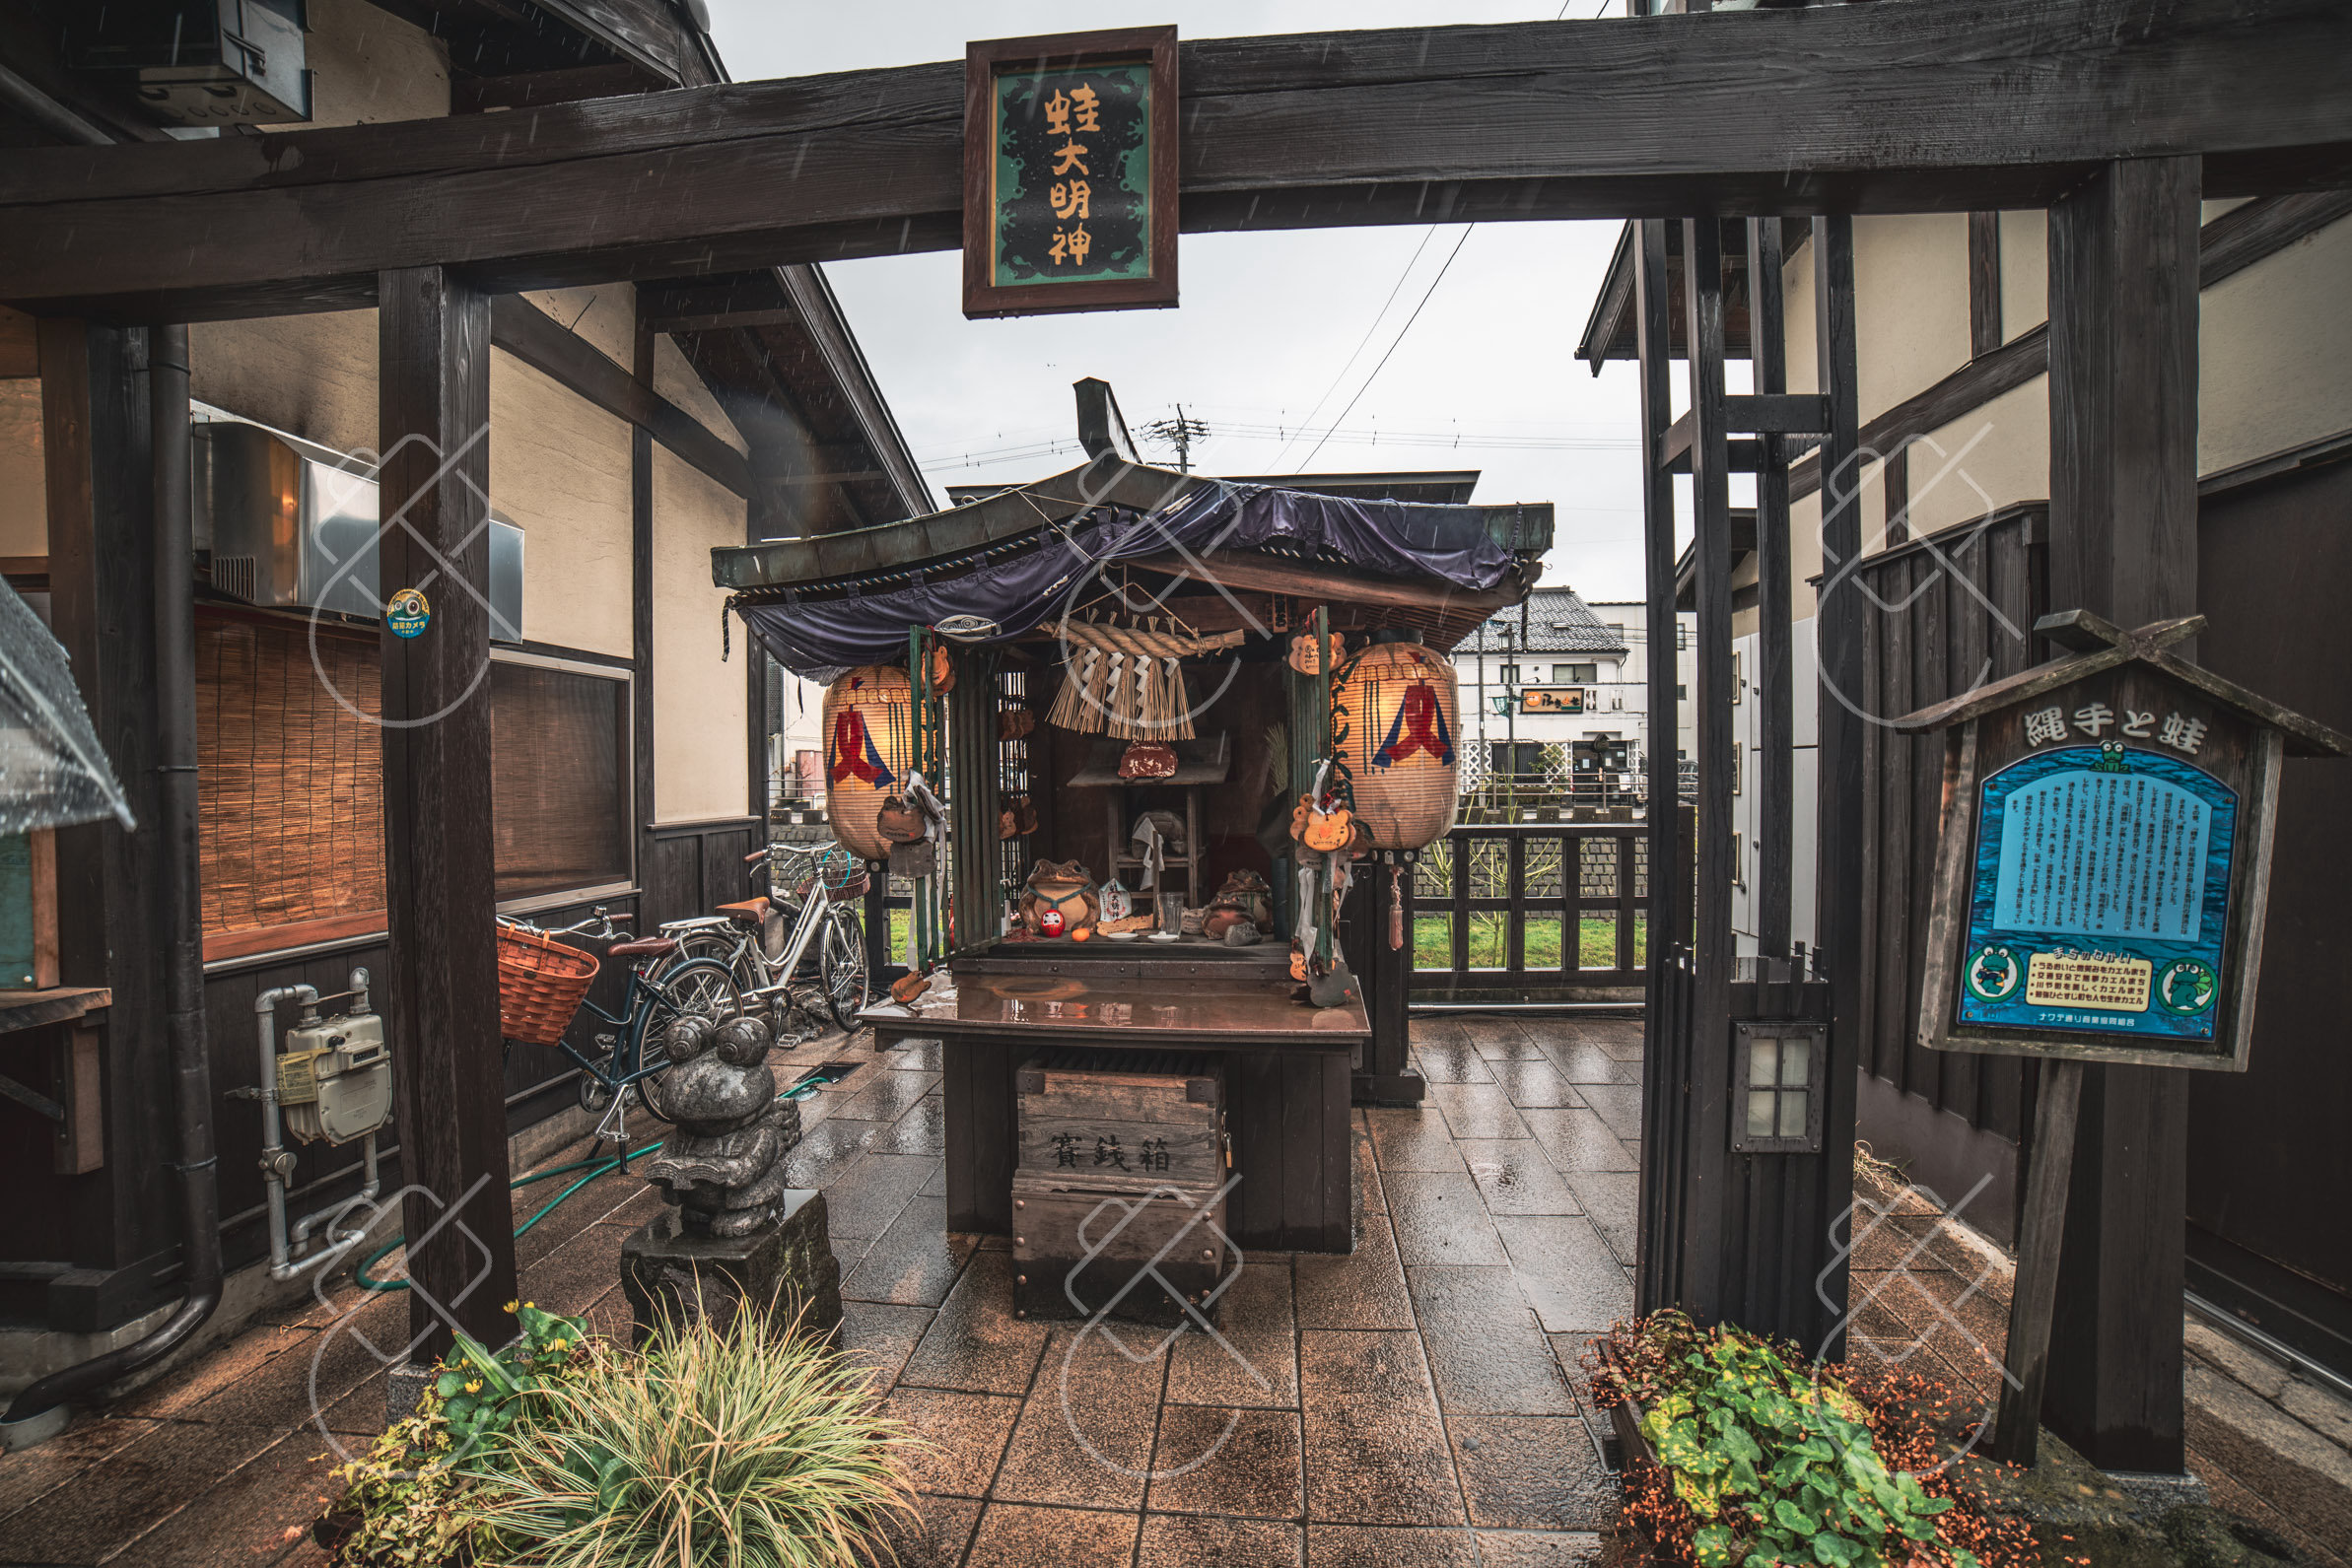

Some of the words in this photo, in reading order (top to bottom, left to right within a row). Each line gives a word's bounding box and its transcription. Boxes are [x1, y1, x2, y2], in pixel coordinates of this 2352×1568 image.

[1045, 83, 1101, 266] 蛙大明神
[2023, 702, 2208, 755] 縄手と蛙
[2052, 946, 2131, 964] まちのねがい
